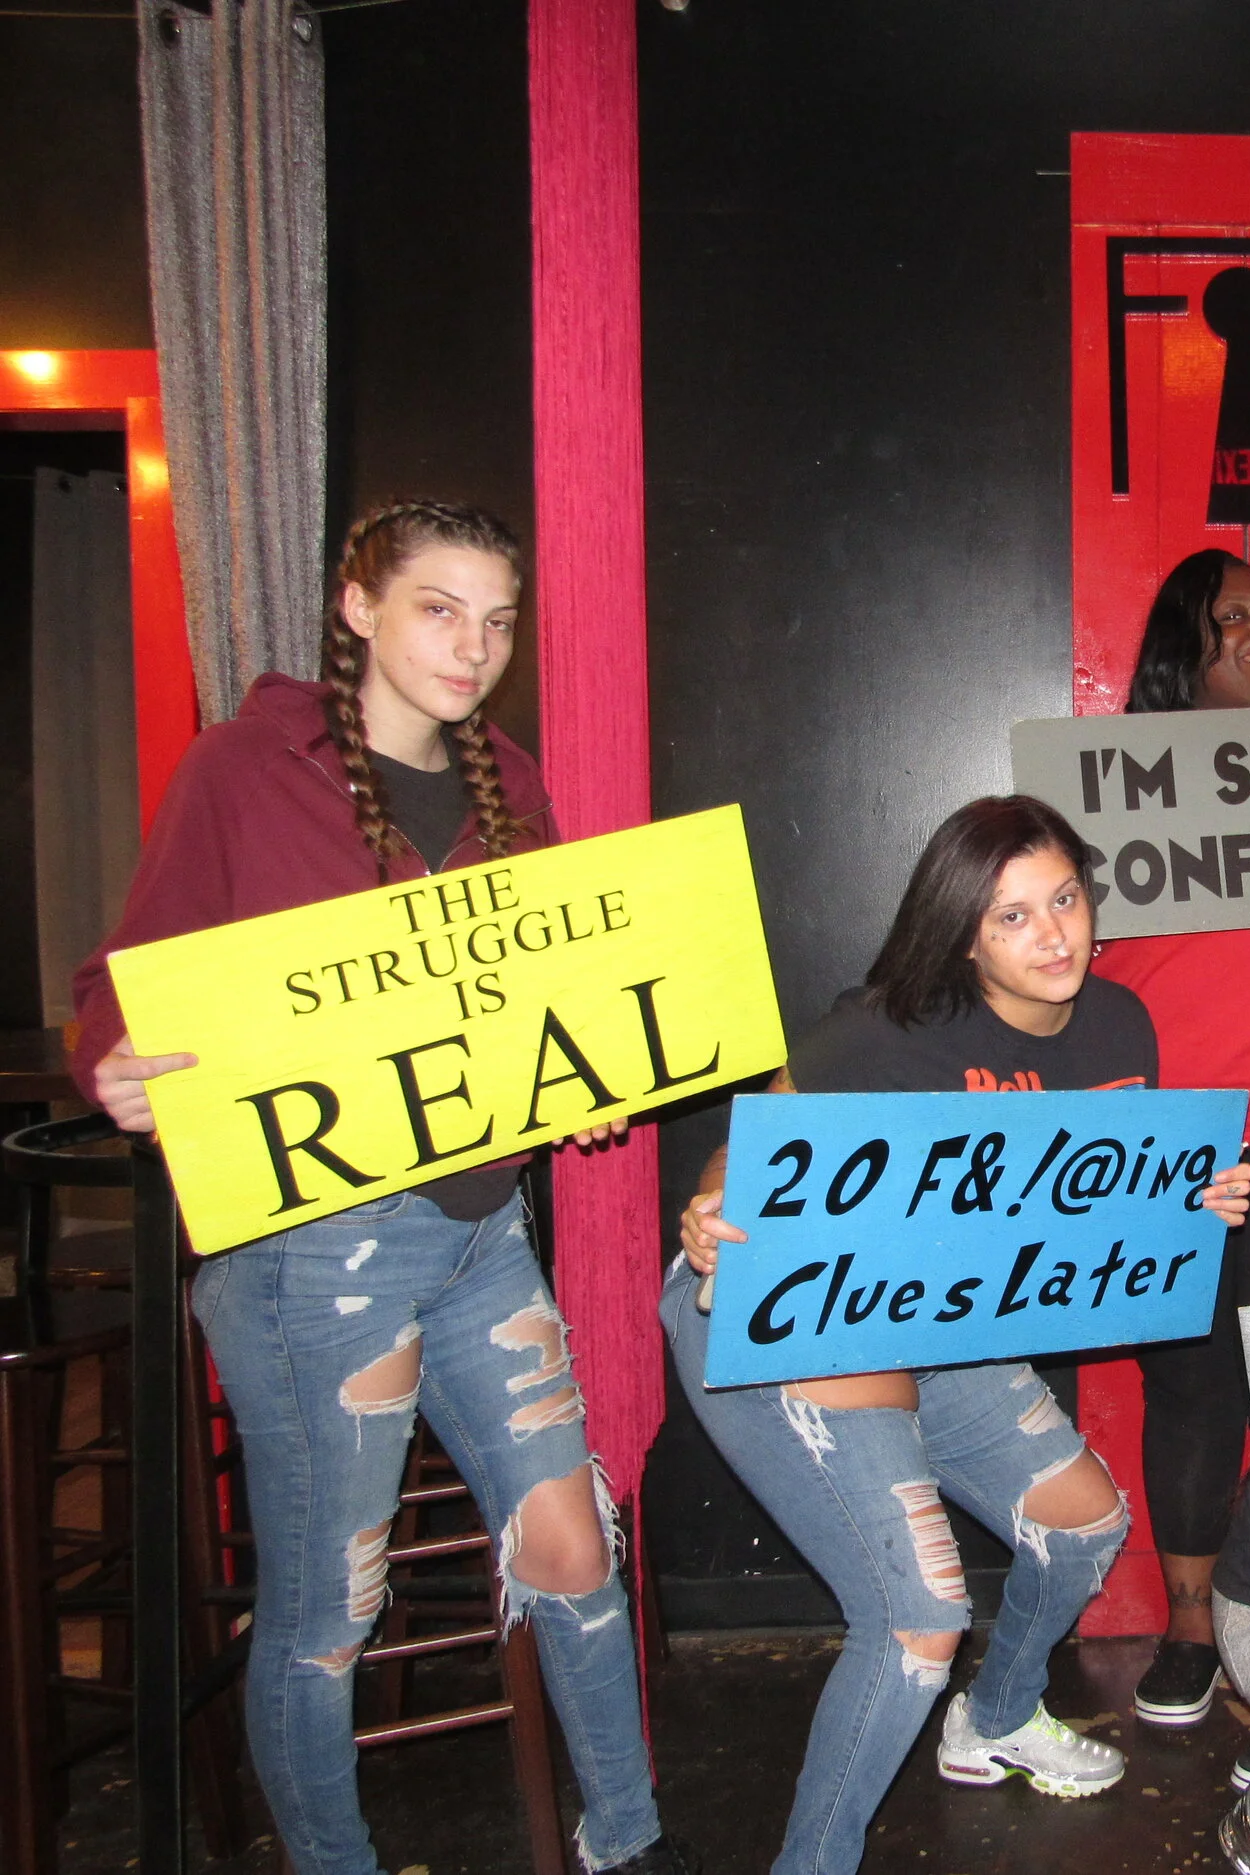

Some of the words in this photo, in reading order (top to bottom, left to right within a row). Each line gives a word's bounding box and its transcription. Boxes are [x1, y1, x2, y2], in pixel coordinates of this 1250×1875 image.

[1080, 746, 1178, 813] I'M
[390, 868, 520, 934] THE
[285, 890, 632, 1016] STRUGGLE
[453, 972, 506, 1021] IS
[235, 977, 721, 1217] REAL
[759, 1138, 890, 1218] 20
[747, 1252, 984, 1345] Clues
[995, 1239, 1197, 1319] Later
